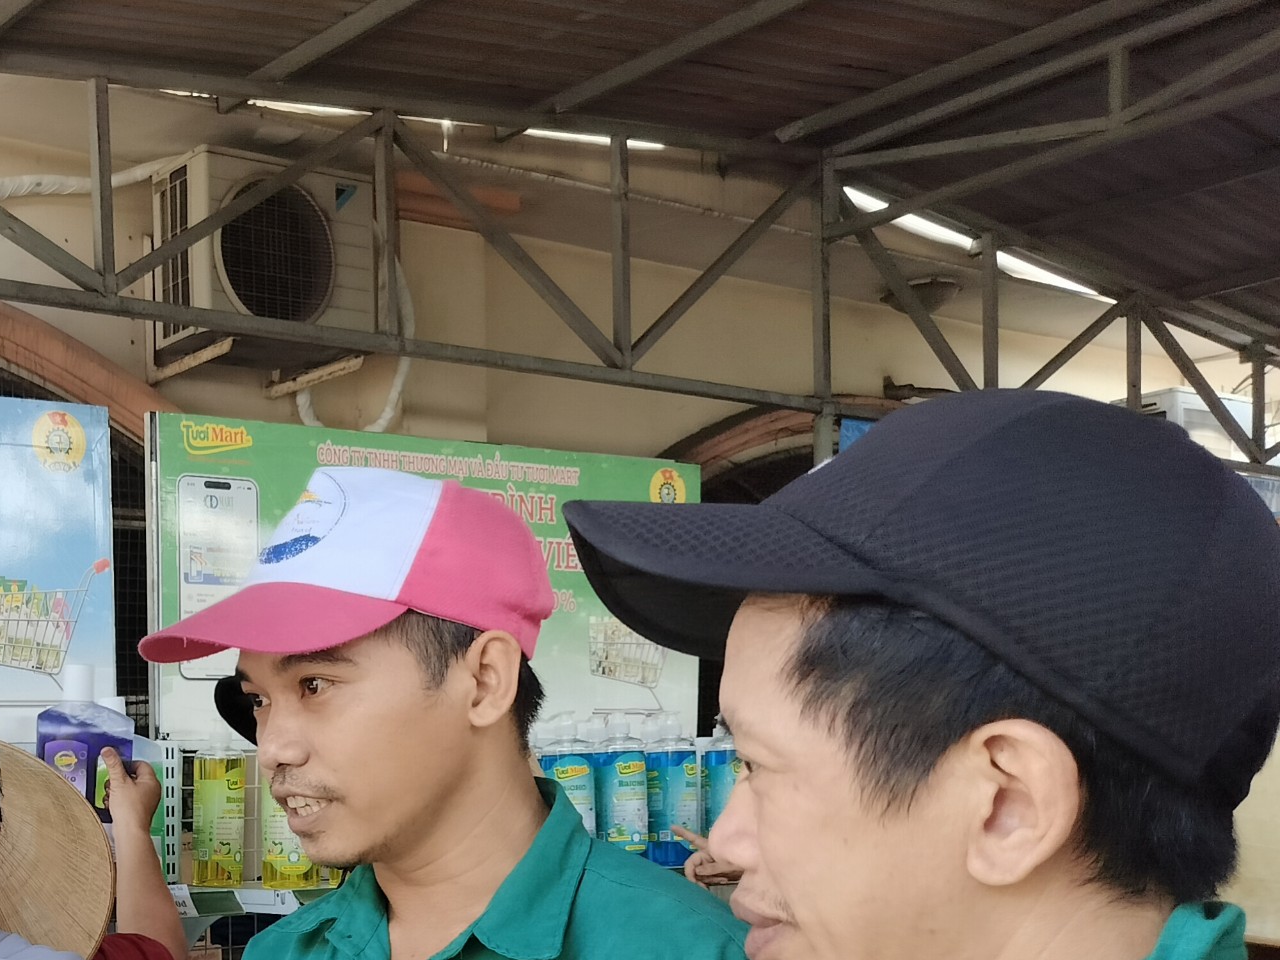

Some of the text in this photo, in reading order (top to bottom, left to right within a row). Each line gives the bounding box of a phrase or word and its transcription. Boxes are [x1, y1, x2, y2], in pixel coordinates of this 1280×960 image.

[317, 440, 350, 465] CÔNG
[351, 448, 365, 466] TY
[367, 451, 399, 470] TNHH
[447, 457, 469, 480] MẠI
[537, 534, 583, 571] VIÊ
